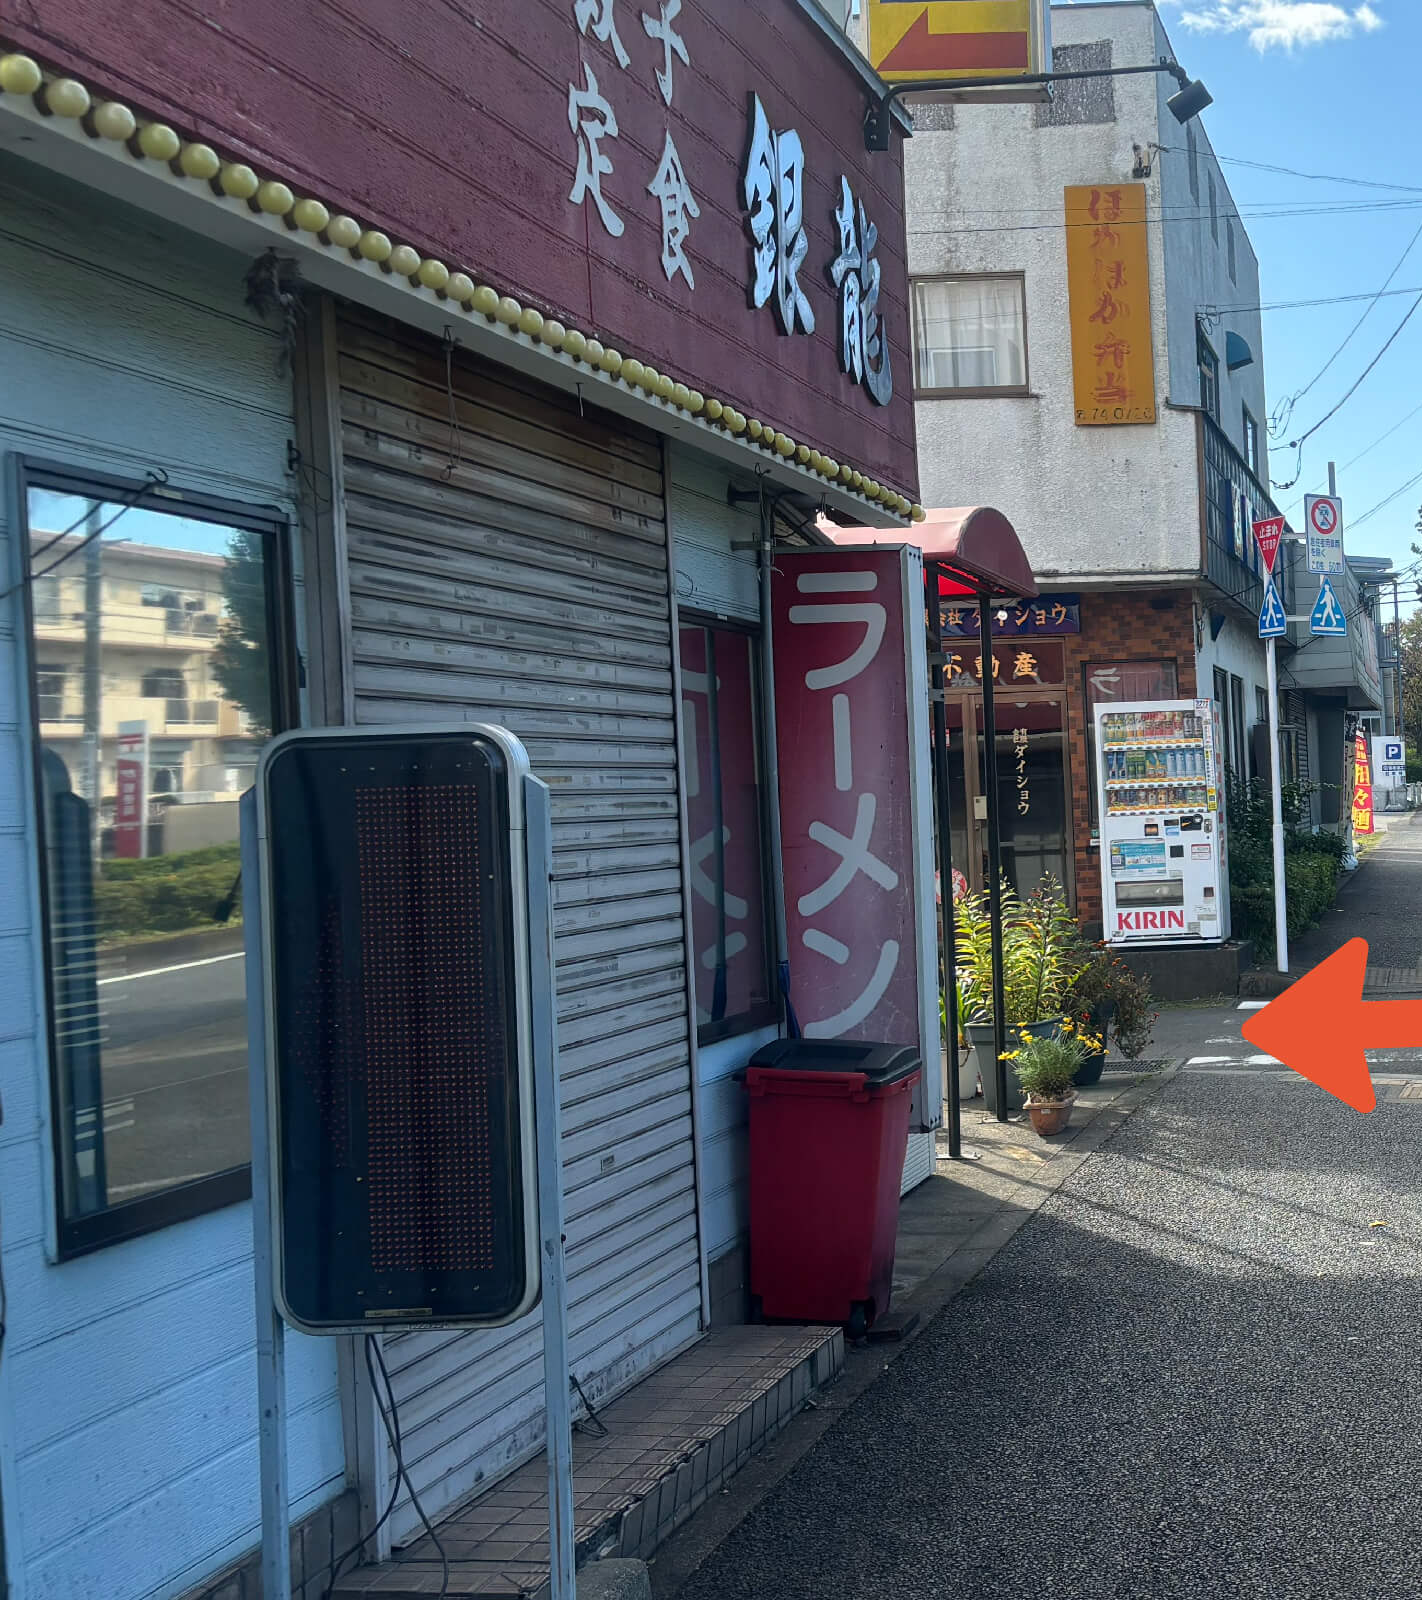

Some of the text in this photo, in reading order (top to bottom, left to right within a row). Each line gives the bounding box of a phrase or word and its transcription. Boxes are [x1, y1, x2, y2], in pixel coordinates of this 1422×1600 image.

[567, 60, 701, 291] 定食
[744, 90, 893, 407] 銀龍
[1259, 526, 1279, 539] 止まれ
[1262, 539, 1277, 551] STOP
[788, 570, 899, 1040] ラーメン
[1117, 910, 1185, 931] KIRIN
